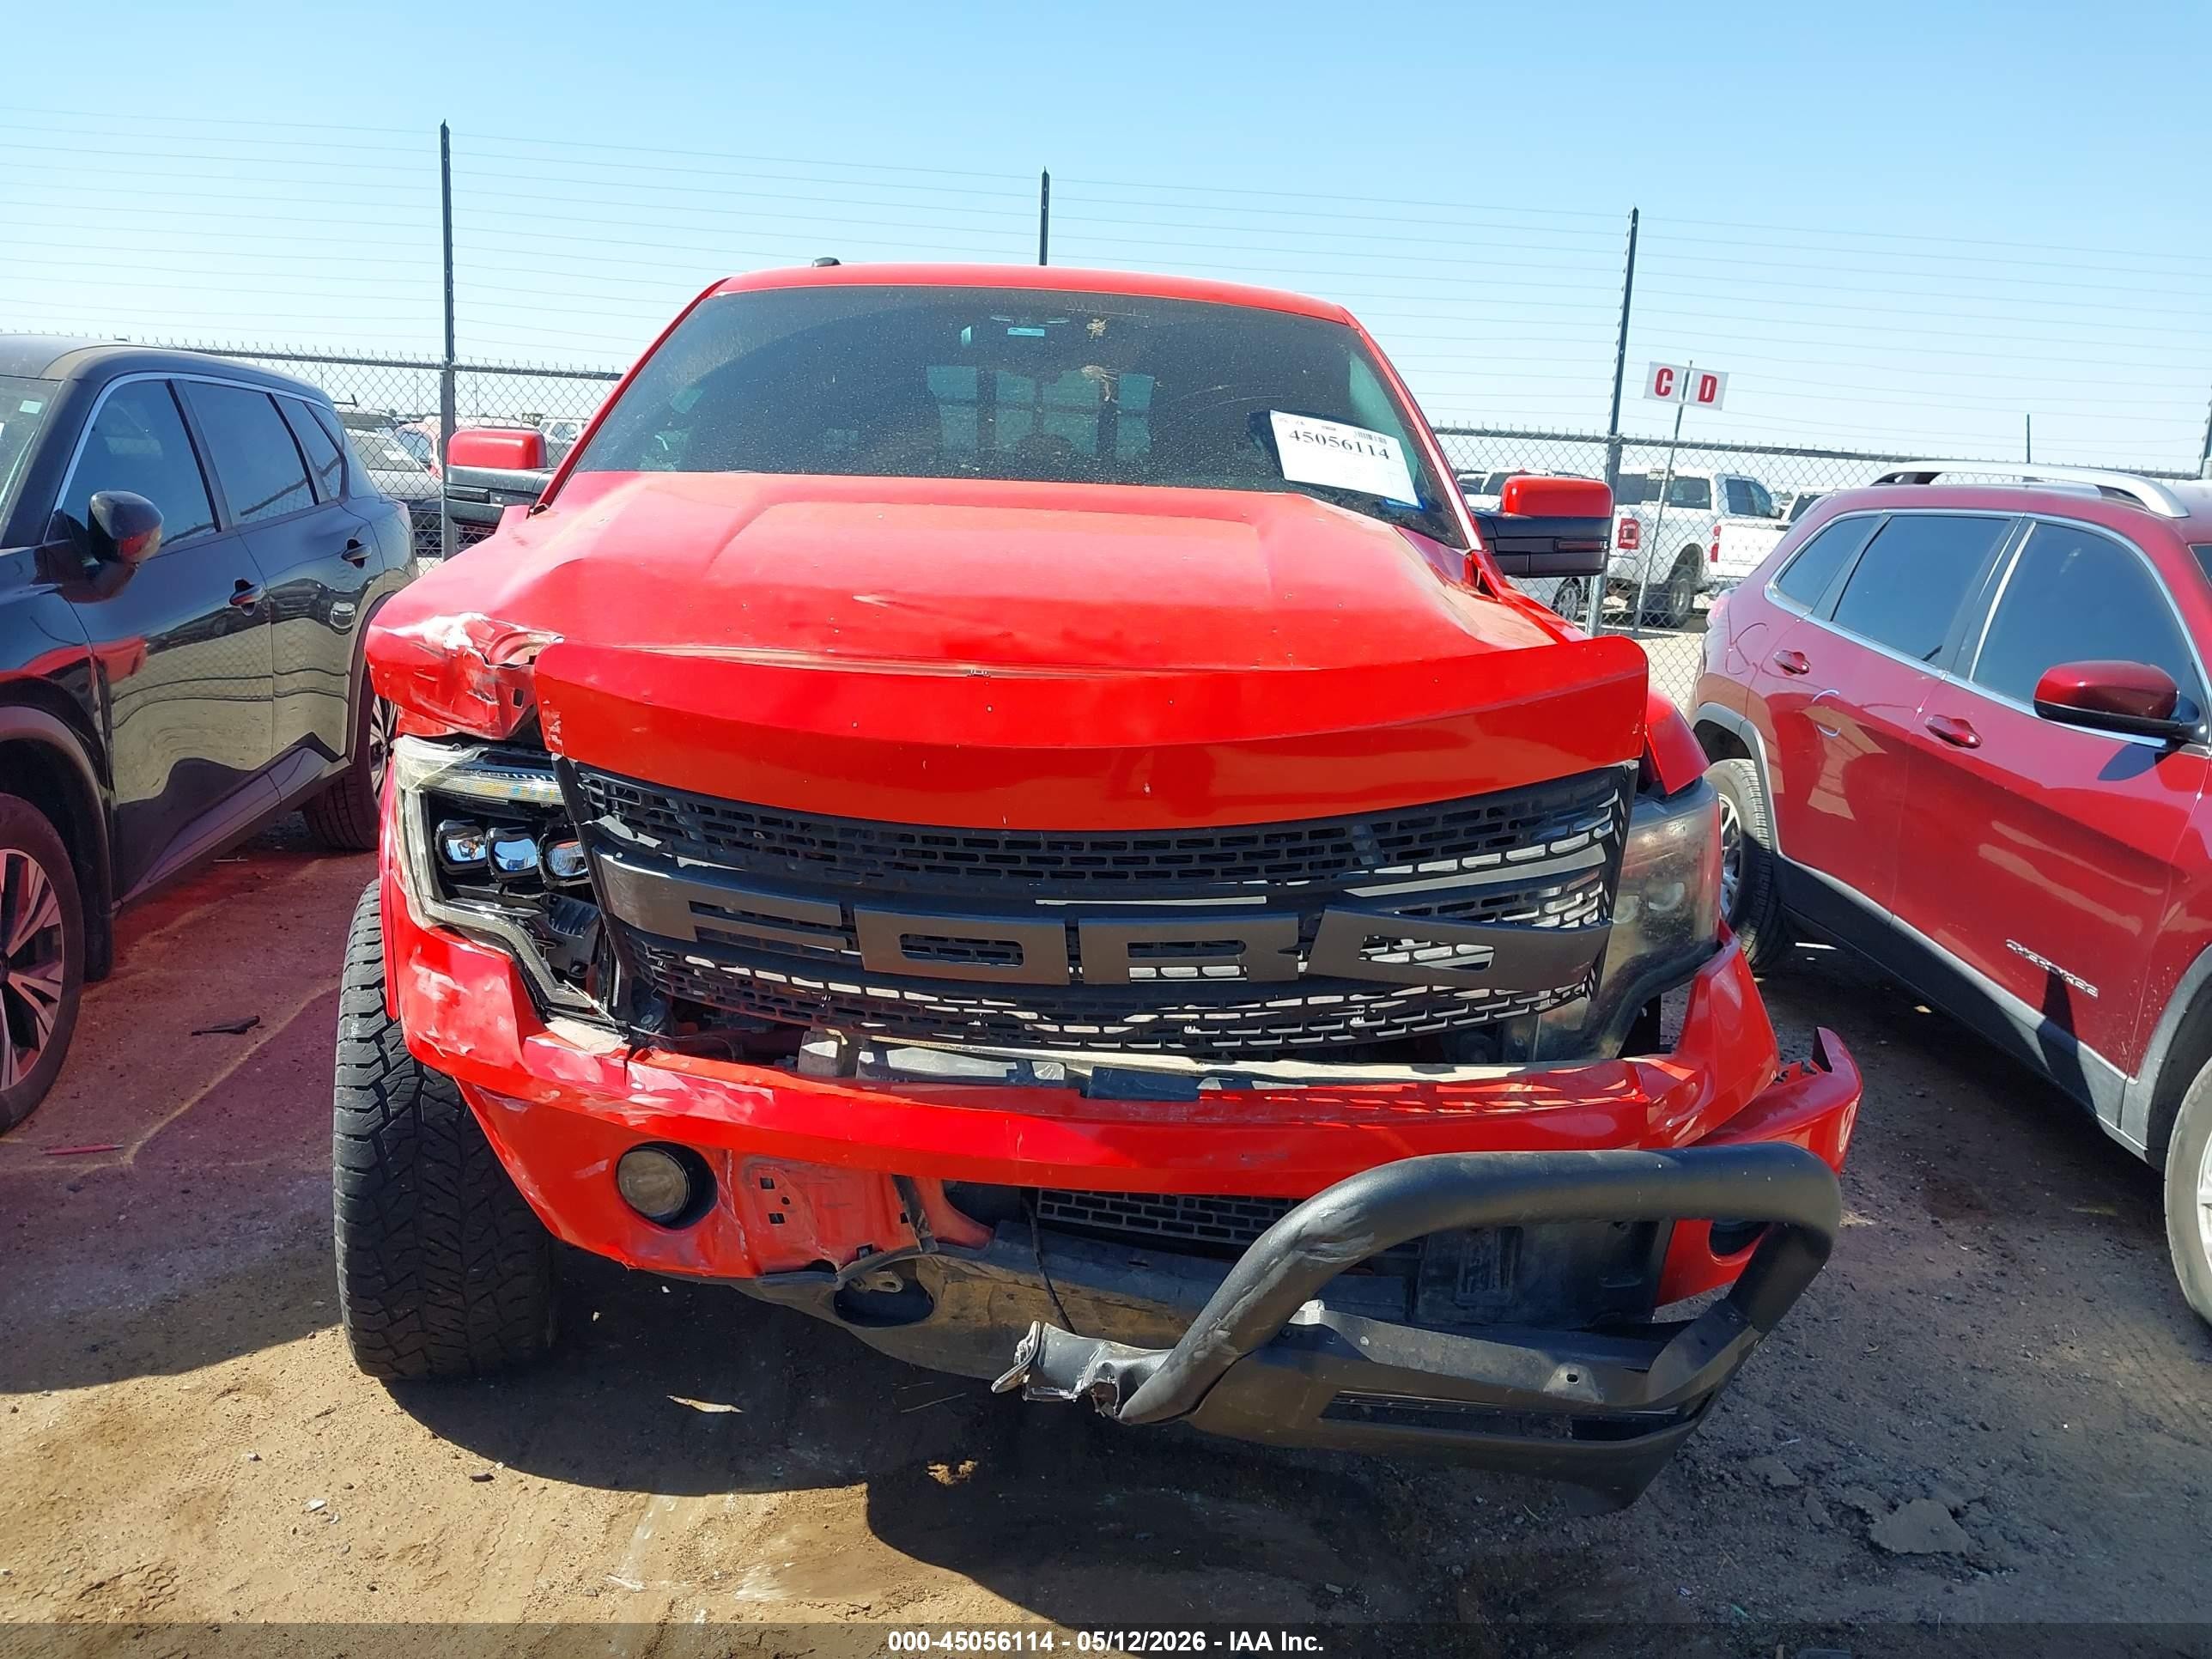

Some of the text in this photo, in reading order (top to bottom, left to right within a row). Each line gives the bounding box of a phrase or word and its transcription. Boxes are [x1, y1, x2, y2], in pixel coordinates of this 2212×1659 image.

[1655, 368, 1717, 403] C D
[1289, 429, 1389, 459] 45056114
[595, 848, 1612, 992] FORD
